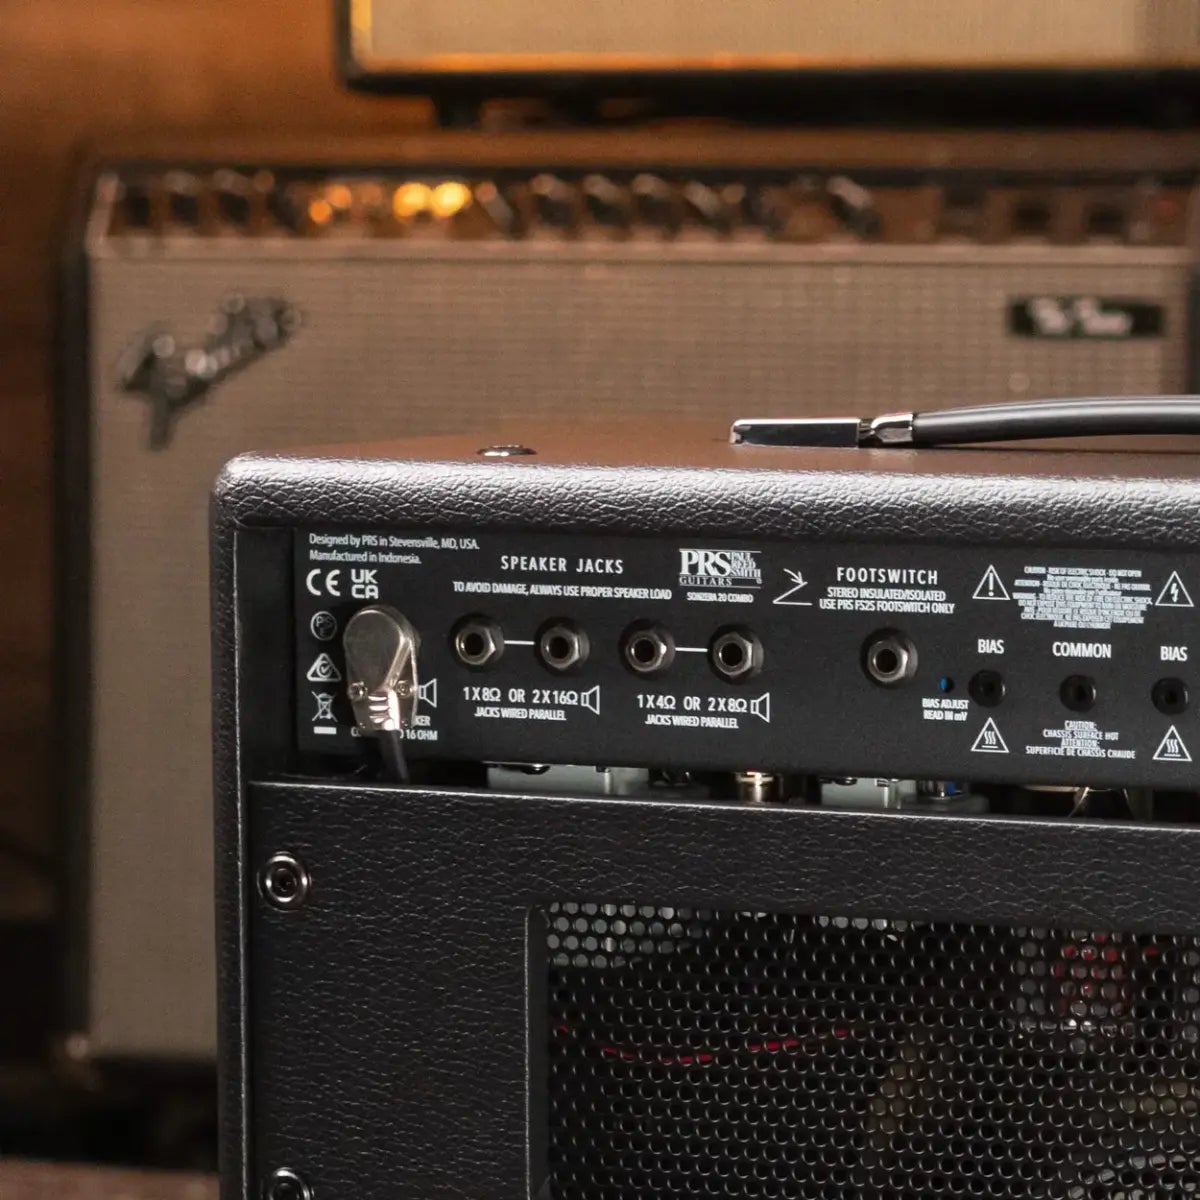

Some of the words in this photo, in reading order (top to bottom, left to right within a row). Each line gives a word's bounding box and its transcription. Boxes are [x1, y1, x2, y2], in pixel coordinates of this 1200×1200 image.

[309, 533, 348, 547] Designed
[350, 535, 361, 548] by
[362, 535, 377, 546] PRS
[379, 536, 388, 546] in
[389, 536, 440, 549] Stevensville,
[441, 538, 458, 550] MD,
[459, 538, 480, 550] USA.
[309, 550, 368, 562] Manufactured
[369, 551, 378, 563] in
[378, 552, 422, 564] Indonesia.
[679, 550, 731, 577] PRS
[500, 555, 567, 572] SPEAKER
[576, 559, 624, 575] JACKS
[306, 568, 341, 597] CE
[351, 569, 378, 584] UK
[679, 576, 732, 586] GUITARS
[836, 567, 938, 585] FOOTSWITCH
[351, 584, 379, 599] CA
[453, 581, 465, 592] TO
[465, 582, 491, 593] AVOID
[492, 583, 529, 596] DAMAGE,
[529, 584, 563, 596] ALWAYS
[563, 585, 579, 597] USE
[580, 586, 613, 598] PROPER
[613, 588, 649, 599] SPEAKER
[650, 588, 673, 600] LOAD
[827, 586, 858, 598] STEREO
[819, 598, 836, 609] USE
[837, 599, 854, 610] PRS
[877, 600, 931, 613] FOOTSWITCH
[931, 602, 955, 614] ONLY
[978, 638, 1005, 654] BIAS
[1052, 641, 1112, 658] COMMON
[1160, 646, 1188, 662] BIAS
[508, 688, 525, 703] OR
[683, 696, 701, 711] OR
[474, 706, 500, 718] JACKS
[501, 707, 528, 719] WIRED
[529, 709, 567, 721] PARALLEL
[644, 714, 671, 726] JACKS
[672, 715, 699, 727] WIRED
[700, 716, 739, 729] PARALLEL
[406, 729, 416, 740] 16
[417, 729, 438, 741] OHM
